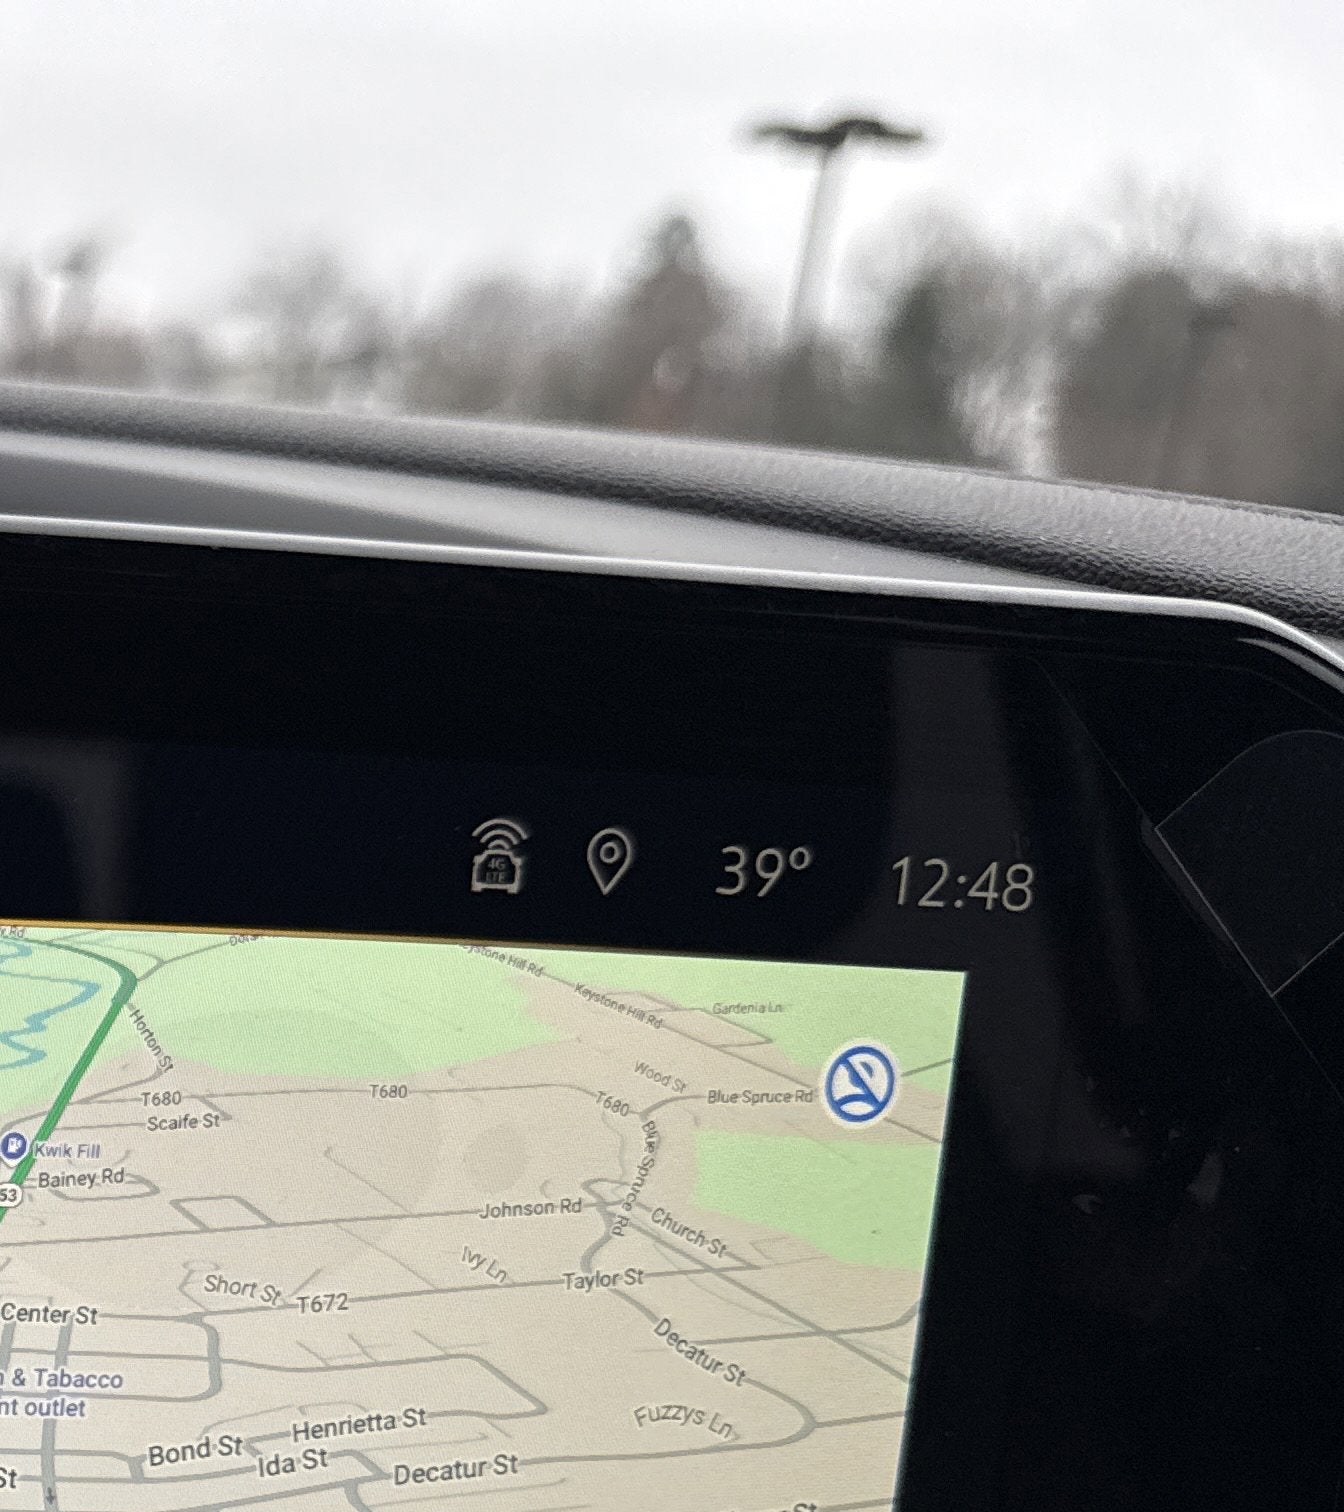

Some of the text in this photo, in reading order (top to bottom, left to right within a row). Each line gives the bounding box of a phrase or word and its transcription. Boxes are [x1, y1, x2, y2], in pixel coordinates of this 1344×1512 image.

[892, 855, 1034, 912] 12:48
[574, 983, 662, 1028] Keystone Hill Rd
[712, 1002, 783, 1015] Gardenia Ln
[129, 1009, 173, 1072] Horton St
[634, 1059, 687, 1094] Wood St
[141, 1090, 182, 1106] T680
[369, 1084, 408, 1099] T680
[596, 1091, 630, 1117] T680
[707, 1090, 814, 1106] Blue Spruce Rd
[147, 1113, 220, 1132] Scaife St
[34, 1142, 101, 1159] Kwik Fill
[39, 1168, 125, 1190] Bainey Rd
[612, 1120, 658, 1237] Blue Spruce Rd
[479, 1198, 582, 1220] Johnson Rd
[650, 1207, 727, 1259] Church St
[461, 1245, 509, 1283] Ivy Ln
[204, 1274, 281, 1305] Short St
[563, 1268, 644, 1293] Taylor St
[0, 1303, 99, 1325] Center St
[296, 1293, 349, 1314] T672
[654, 1318, 748, 1387] Decatur St
[13, 1368, 26, 1388] &
[34, 1368, 124, 1389] Tabacco
[24, 1397, 86, 1418] outlet
[634, 1404, 733, 1438] Fuzzys Ln
[292, 1408, 427, 1443] Henrietta St
[148, 1435, 244, 1467] Bond St
[259, 1449, 329, 1478] Ida St
[393, 1453, 518, 1485] Decatur St
